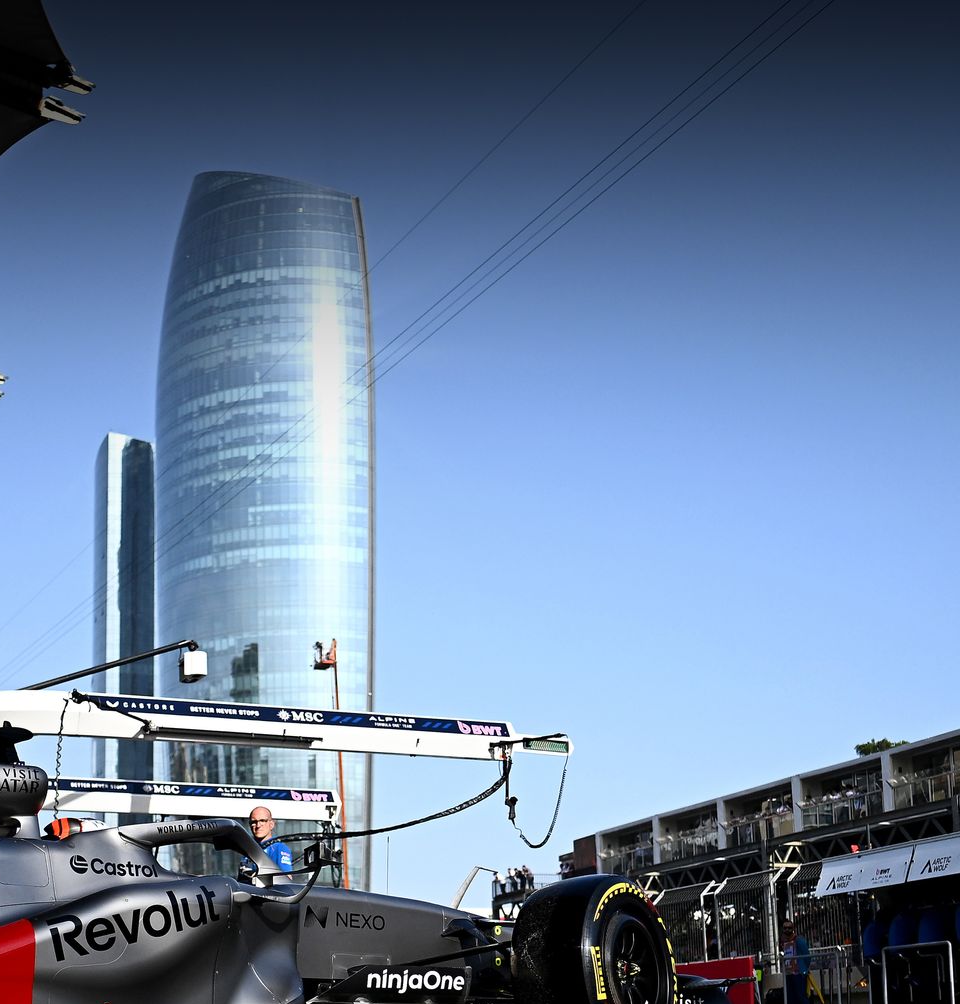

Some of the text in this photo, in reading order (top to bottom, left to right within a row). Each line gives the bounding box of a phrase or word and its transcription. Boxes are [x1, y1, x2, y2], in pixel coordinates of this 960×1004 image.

[123, 701, 175, 711] CASTORE
[238, 709, 259, 717] STOPS
[291, 710, 324, 722] MSC
[368, 715, 416, 724] ALPINE
[472, 725, 502, 736] BWT
[2, 765, 40, 780] visit
[153, 784, 180, 794] MSC
[301, 792, 328, 802] BWT
[156, 824, 184, 834] WORLD
[186, 823, 196, 832] OF
[932, 856, 952, 865] ARCTIC
[90, 857, 159, 878] Castrol
[933, 863, 948, 873] WOLF
[836, 874, 852, 883] ARCTIC
[836, 880, 849, 889] WOLF
[46, 885, 220, 962] Revolut
[336, 911, 385, 931] NEXO
[366, 968, 465, 994] ninjaOne
